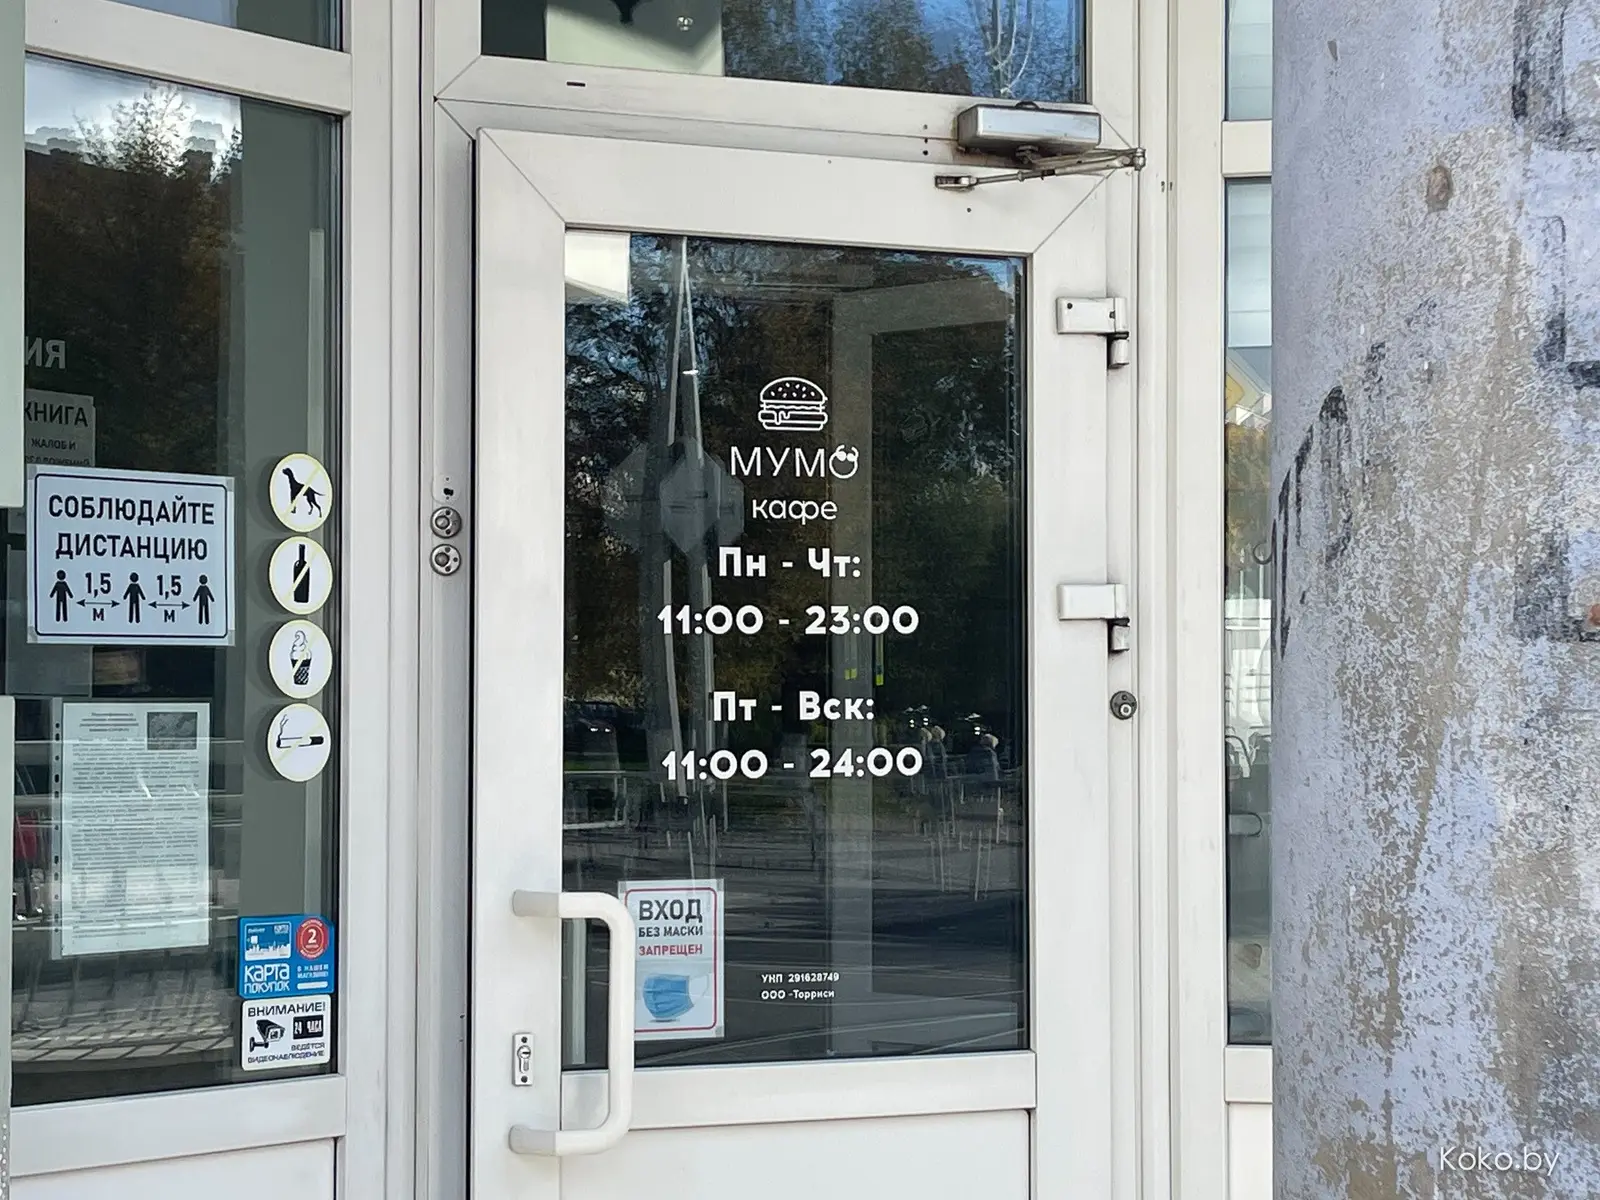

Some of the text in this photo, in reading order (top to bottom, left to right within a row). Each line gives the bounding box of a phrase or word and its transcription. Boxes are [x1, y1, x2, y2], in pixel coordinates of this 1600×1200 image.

[48, 494, 215, 526] СОБЛЮДАЙТЕ
[752, 499, 838, 525] кафе
[55, 532, 208, 563] ДИСТАНЦИЮ
[718, 546, 861, 577] Пн - Чт:
[84, 572, 182, 600] 1,5 1,5
[657, 604, 920, 635] 11:00 - 23:00
[713, 690, 875, 721] Пт - Вск:
[661, 746, 923, 780] 11:00 - 24:00
[638, 898, 703, 923] ВХОД
[307, 928, 317, 944] 2
[638, 925, 703, 938] БЕЗ МАСКИ
[638, 944, 703, 956] ЗАПРЕЩЕН
[761, 973, 783, 983] УНП
[761, 989, 786, 1000] ООО
[247, 1002, 326, 1017] ВНИМАНИЕ!
[294, 1021, 303, 1034] 24
